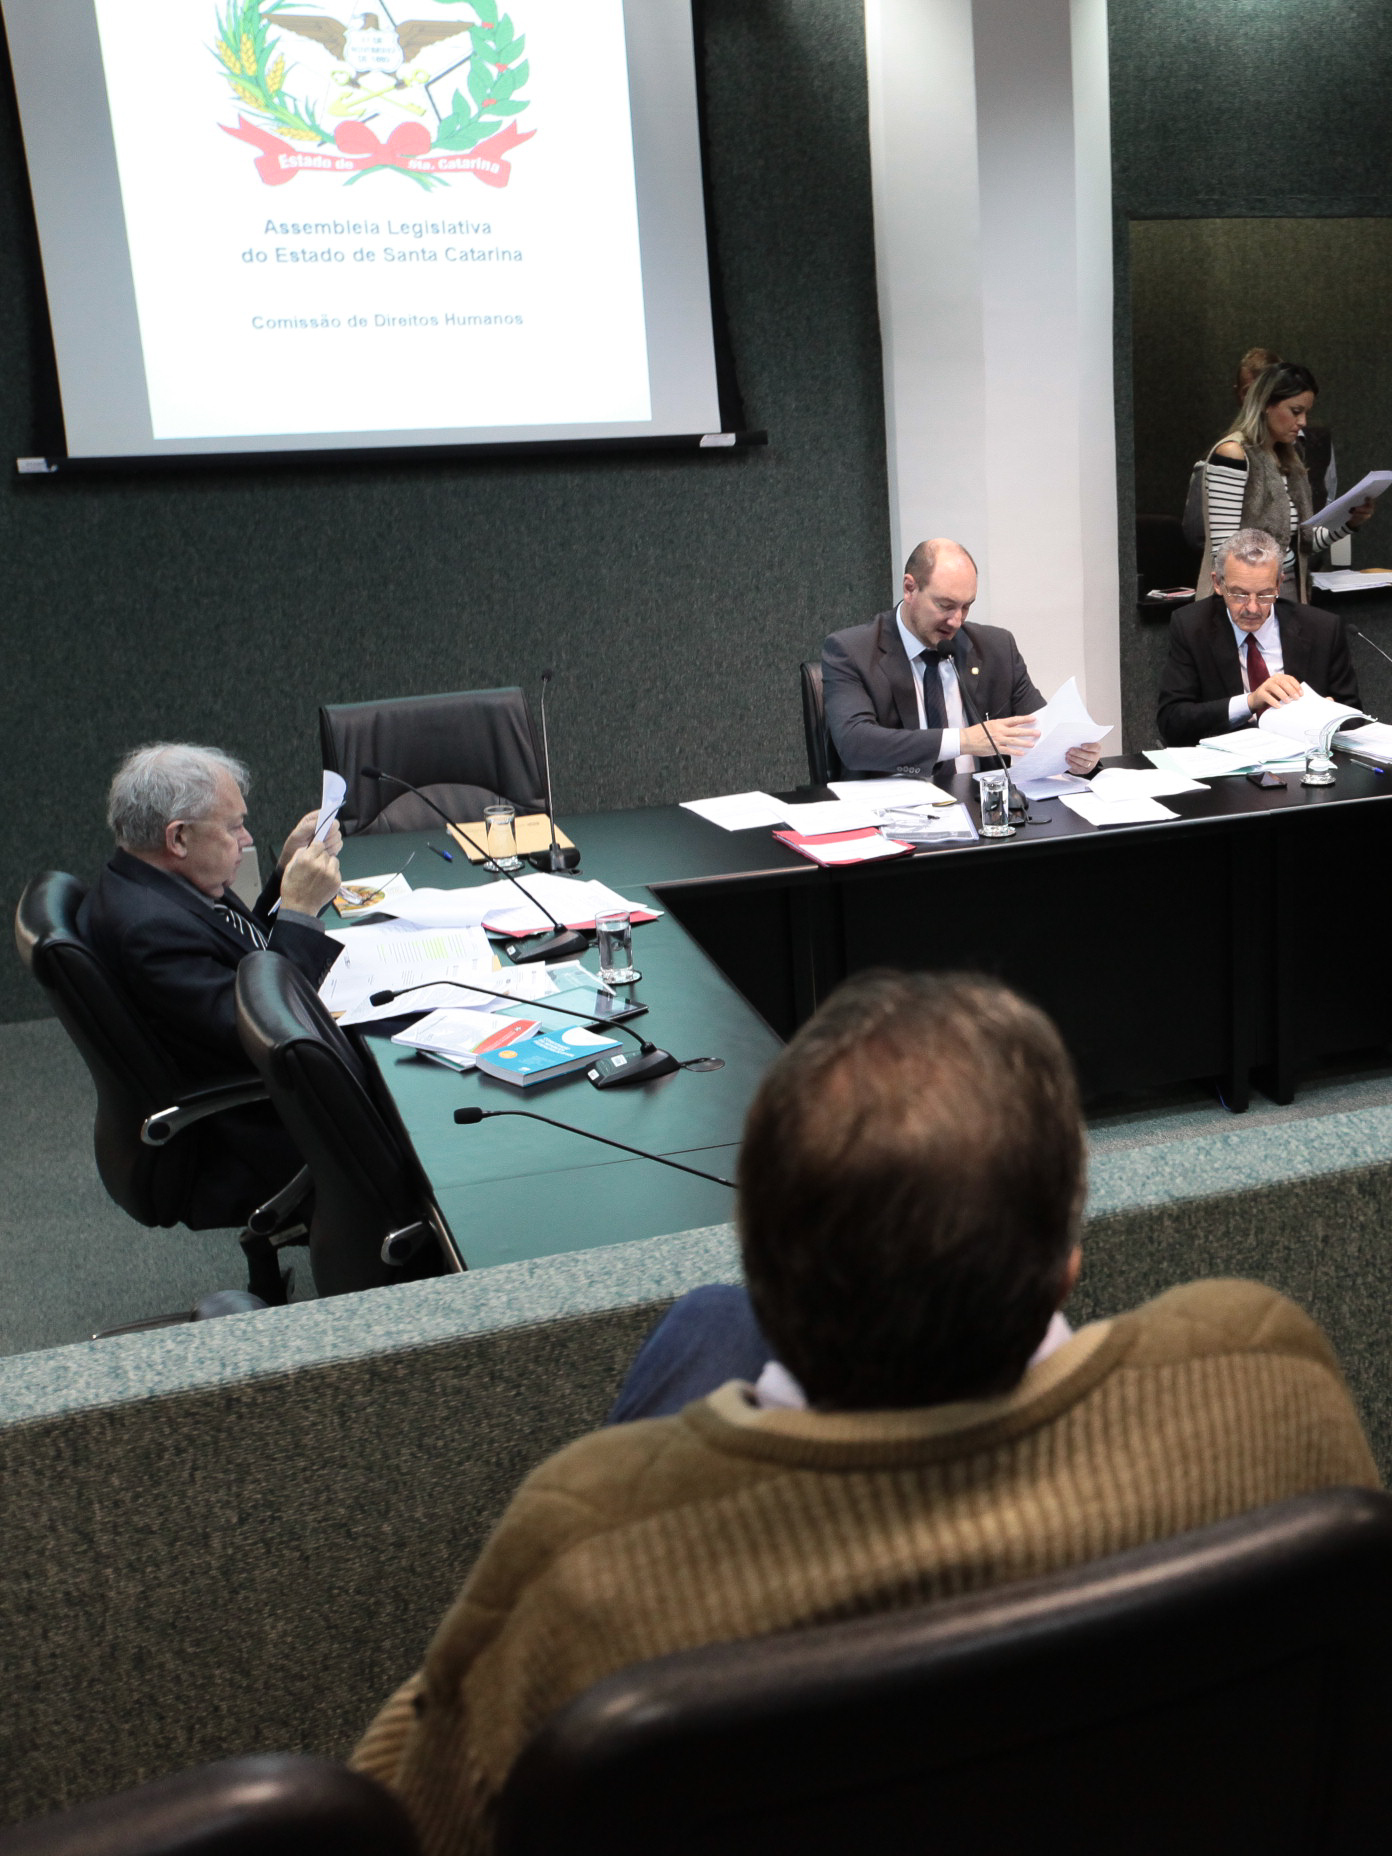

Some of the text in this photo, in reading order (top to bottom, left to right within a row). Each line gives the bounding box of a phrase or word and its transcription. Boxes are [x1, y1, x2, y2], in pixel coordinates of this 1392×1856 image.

[278, 154, 354, 170] Estado de
[408, 157, 500, 174] Sta. Catarina
[264, 219, 492, 239] Assembleia Legislativa
[241, 247, 523, 263] do Estado de Santa Catarina
[251, 312, 524, 330] Comissão de Direitos Humanos
